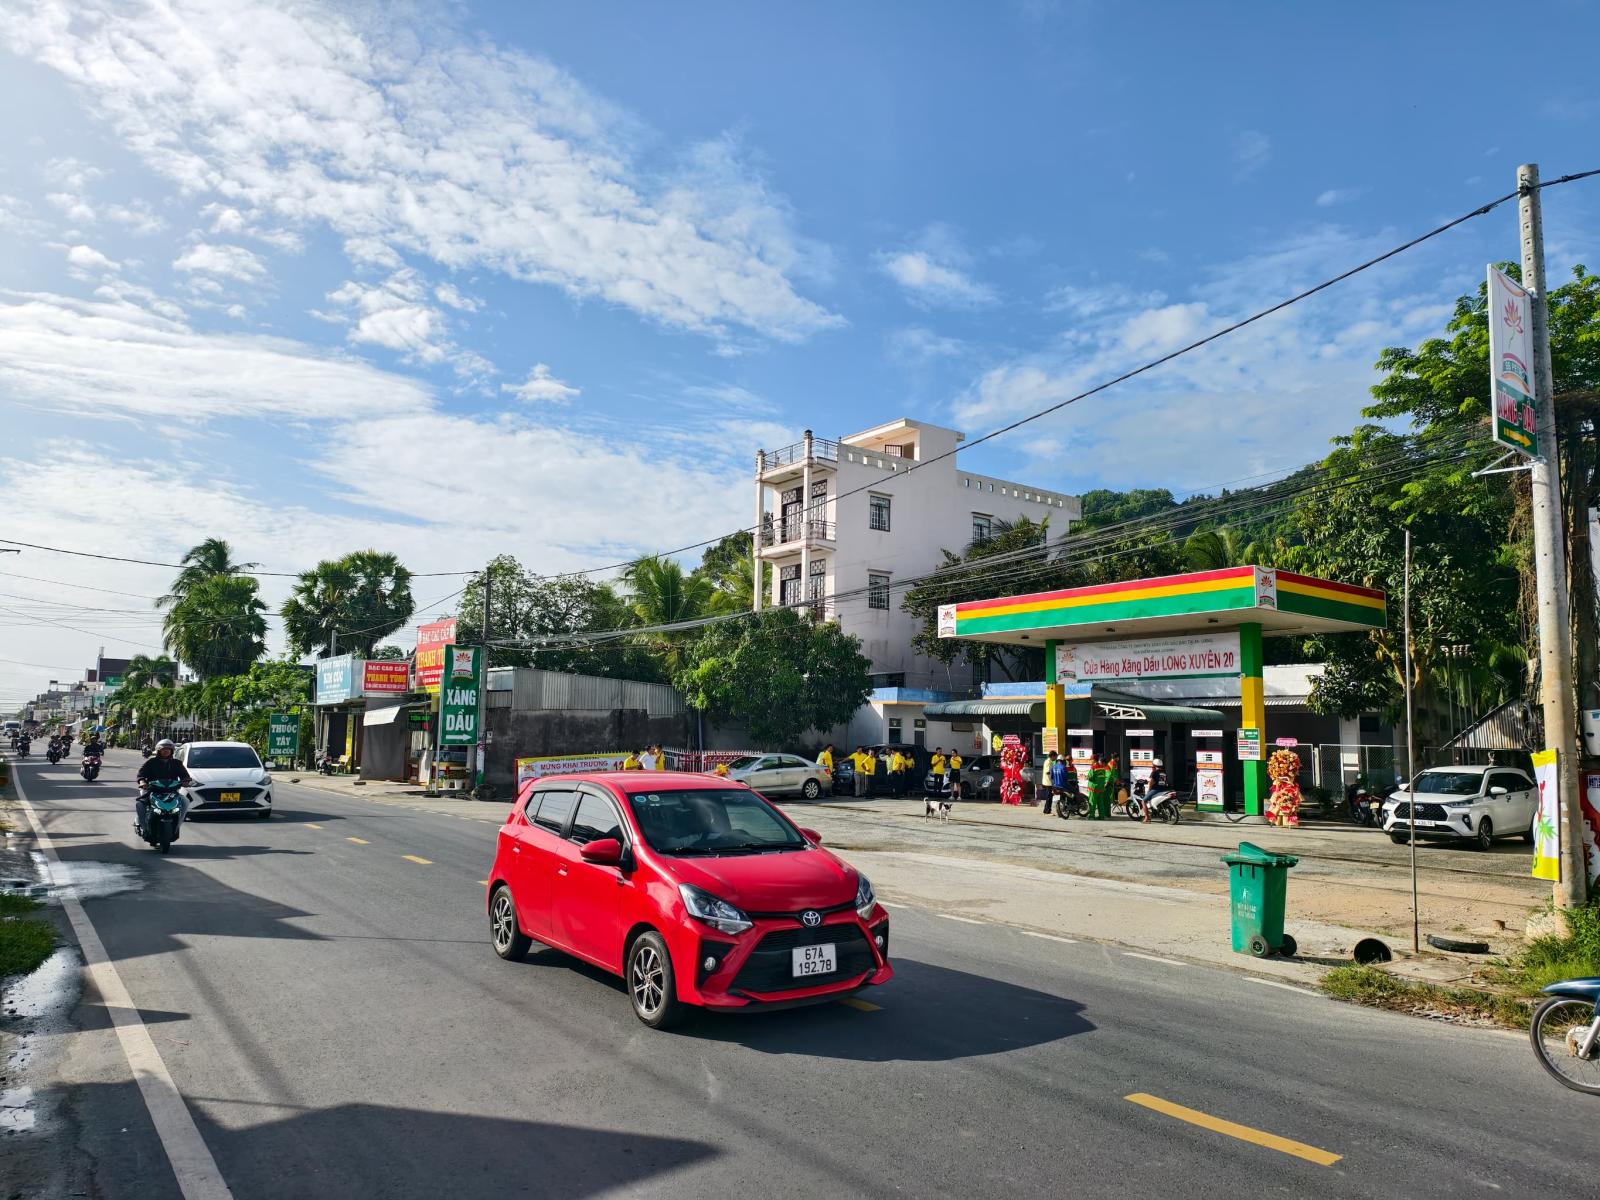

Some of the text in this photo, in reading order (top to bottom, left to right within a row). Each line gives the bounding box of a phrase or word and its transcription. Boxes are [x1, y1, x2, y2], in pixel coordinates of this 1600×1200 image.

[1100, 658, 1120, 677] Hàng
[1121, 657, 1142, 676] Xăng
[1143, 654, 1160, 672] Dầu
[1162, 654, 1187, 671] LONG
[1189, 649, 1221, 670] XUYÊN
[1223, 651, 1234, 668] 20
[446, 685, 476, 706] XĂNG
[445, 708, 474, 731] DẦU
[271, 722, 297, 733] THUỐC
[276, 735, 291, 746] TÂY
[562, 761, 578, 769] KHAI
[805, 947, 824, 960] 67A
[799, 959, 832, 974] 192.78
